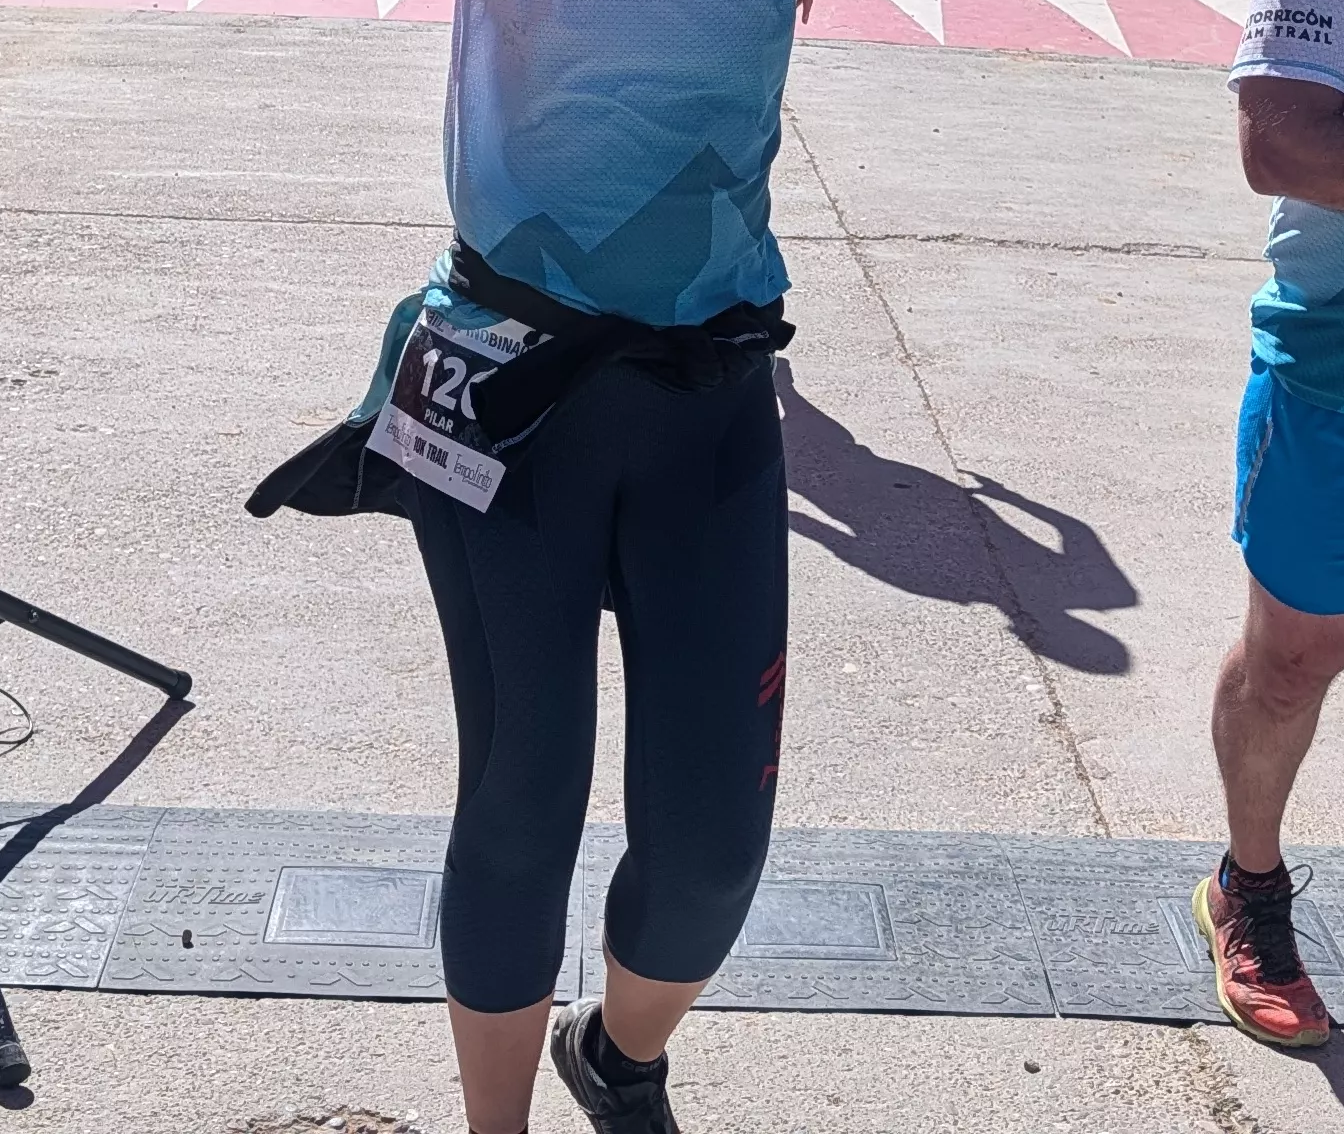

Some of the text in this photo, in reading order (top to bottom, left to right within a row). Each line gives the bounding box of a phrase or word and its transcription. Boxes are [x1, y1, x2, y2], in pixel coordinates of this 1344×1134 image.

[1274, 25, 1333, 46] TRAIL
[423, 407, 454, 434] PILAR
[412, 434, 427, 458] 10K
[425, 442, 450, 470] TRAIL
